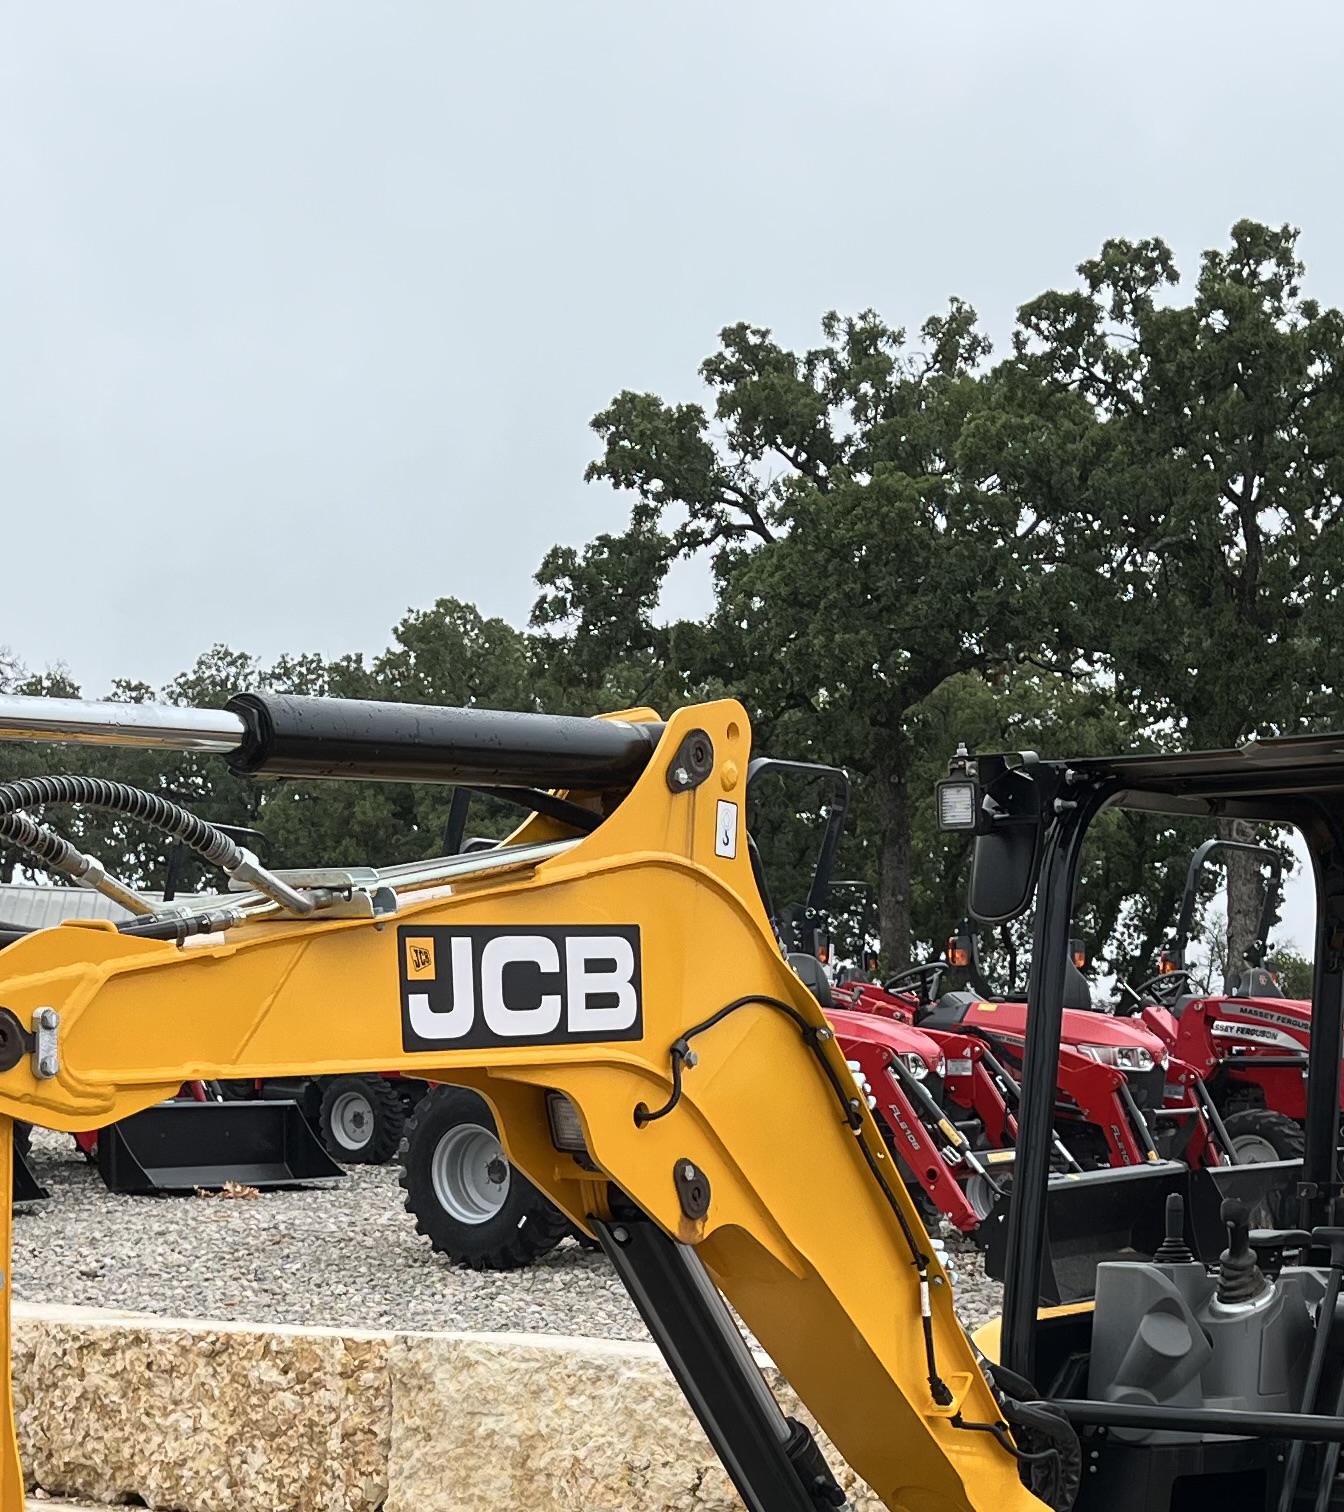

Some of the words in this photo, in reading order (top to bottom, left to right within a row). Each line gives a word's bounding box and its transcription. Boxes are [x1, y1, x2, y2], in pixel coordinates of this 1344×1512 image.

[412, 947, 432, 969] JCB
[408, 935, 638, 1040] JCB
[1239, 1007, 1275, 1020] MASSEY
[1276, 1015, 1311, 1030] FERGUS
[1236, 1026, 1279, 1041] FERGUSON
